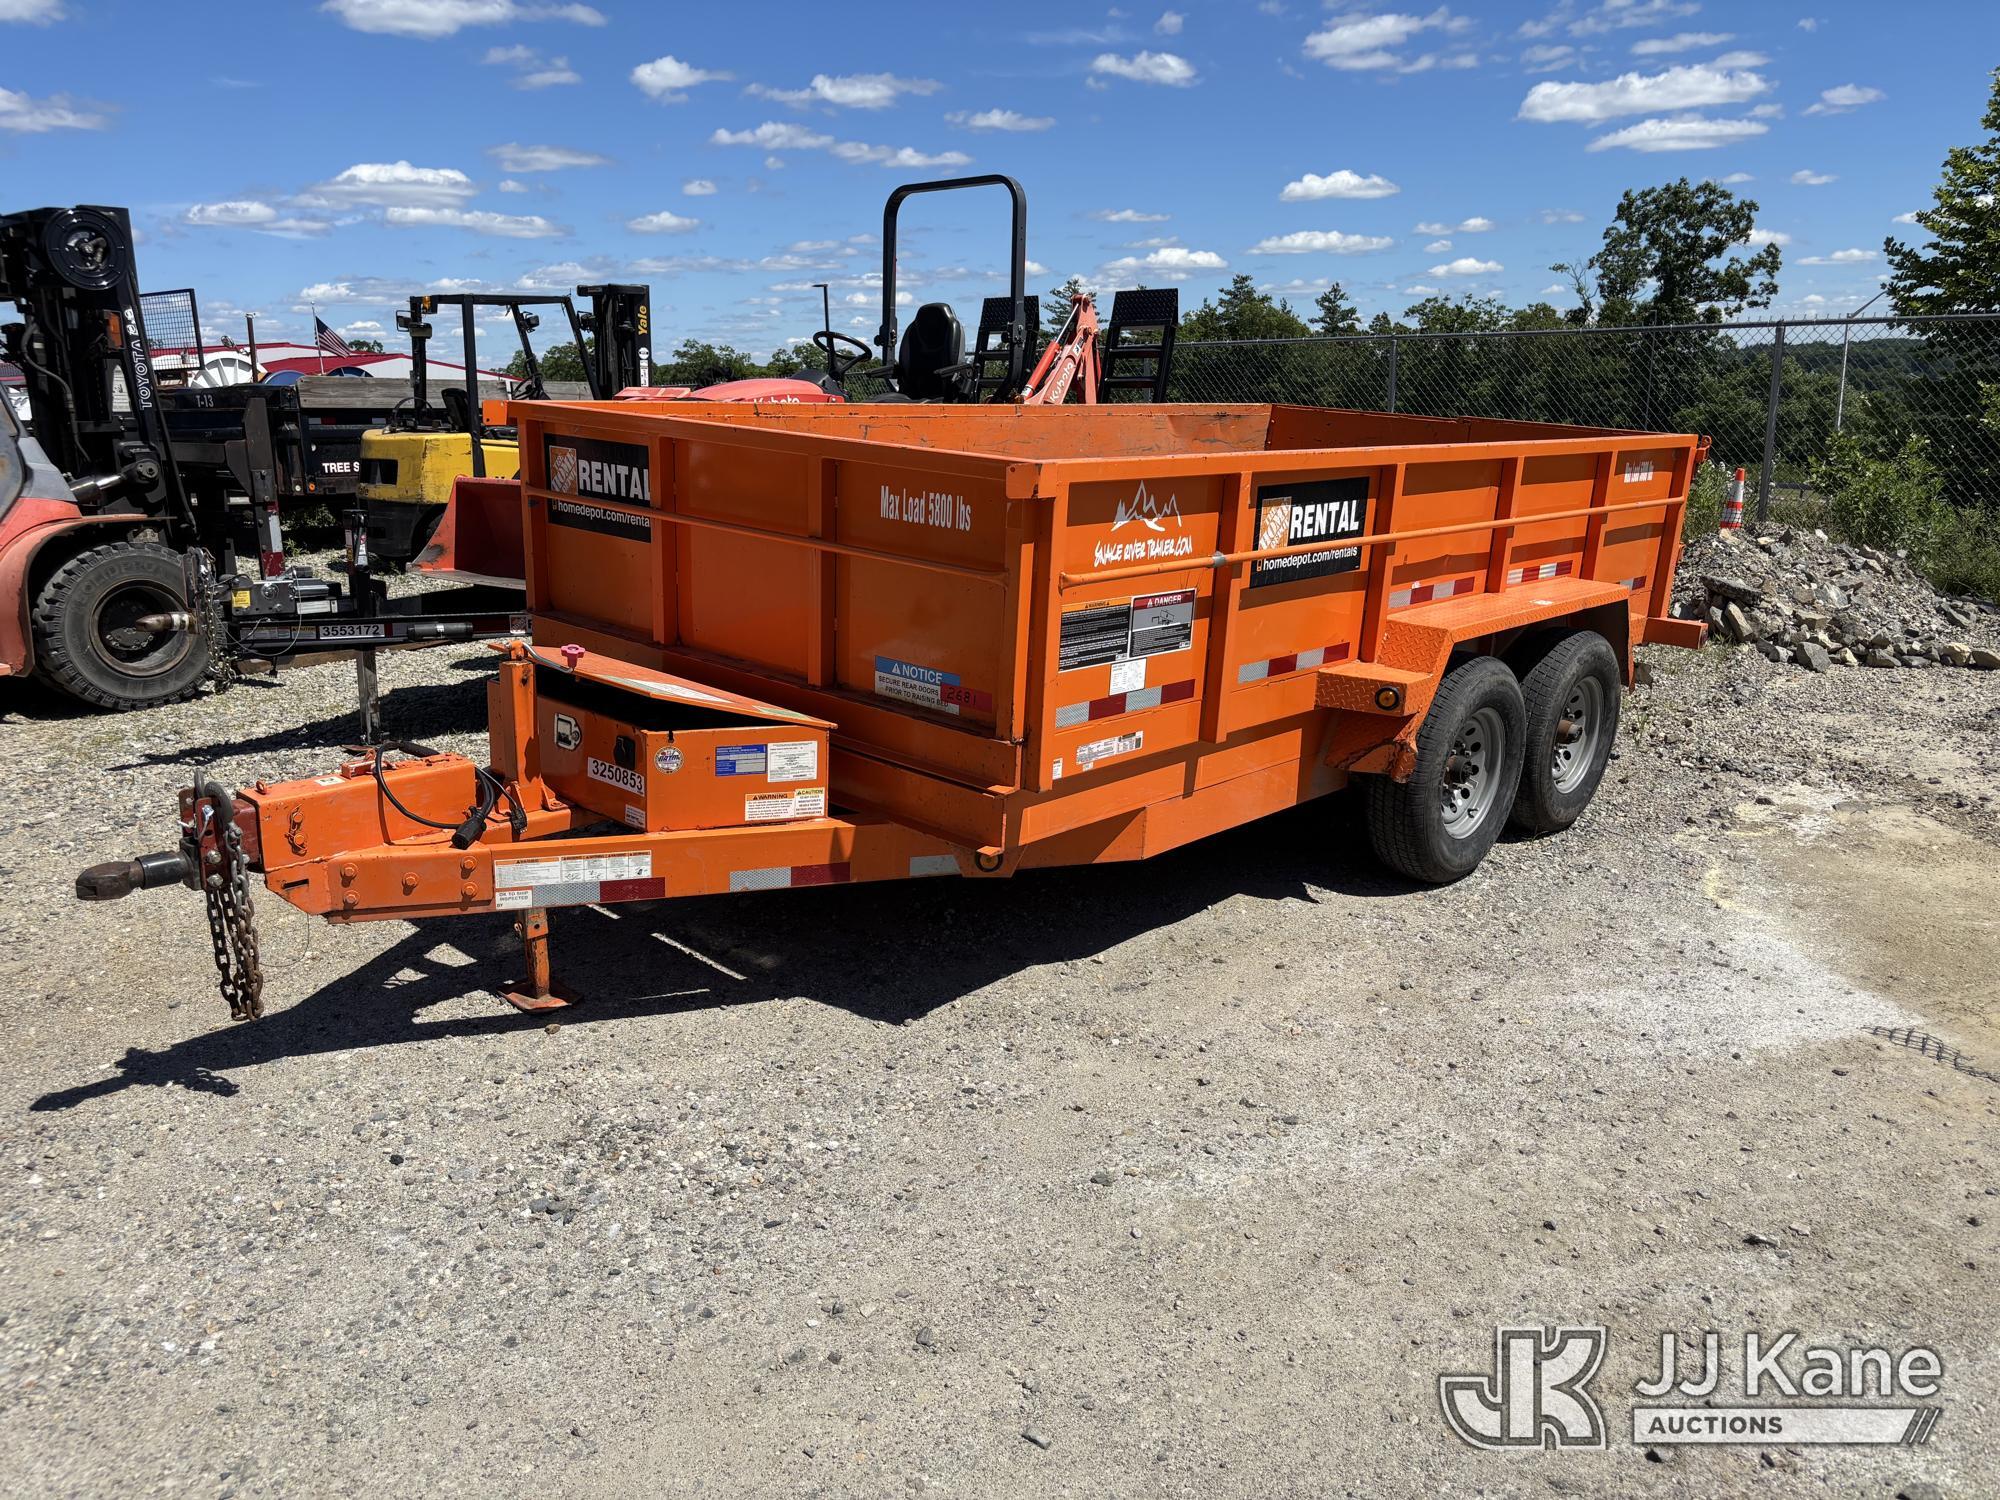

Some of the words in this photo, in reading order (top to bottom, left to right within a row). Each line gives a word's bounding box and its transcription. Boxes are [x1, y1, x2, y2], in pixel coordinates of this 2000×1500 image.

[637, 305, 648, 336] Yale
[131, 340, 152, 411] TOYOTA
[1049, 361, 1074, 402] Kubota
[195, 394, 214, 408] T-13
[322, 462, 350, 474] TREE
[578, 459, 651, 501] RENTAL
[880, 485, 900, 520] Max
[902, 488, 926, 524] Load
[928, 492, 952, 528] 5800
[956, 495, 972, 532] lbs
[1290, 500, 1359, 540] RENTAL
[1094, 541, 1123, 568] SNAKE
[1124, 538, 1146, 560] RIVER
[1263, 546, 1358, 570] homedepot.com/rentals
[1154, 594, 1182, 607] DANGER
[322, 625, 380, 637] 3553172
[878, 675, 900, 687] SECURE
[902, 681, 917, 692] REAR
[918, 685, 939, 696] DOORS
[902, 663, 942, 684] NOTICE
[885, 686, 901, 696] PRIOR
[903, 690, 911, 698] TO
[912, 693, 935, 704] RAISING
[592, 760, 643, 792] 3250853
